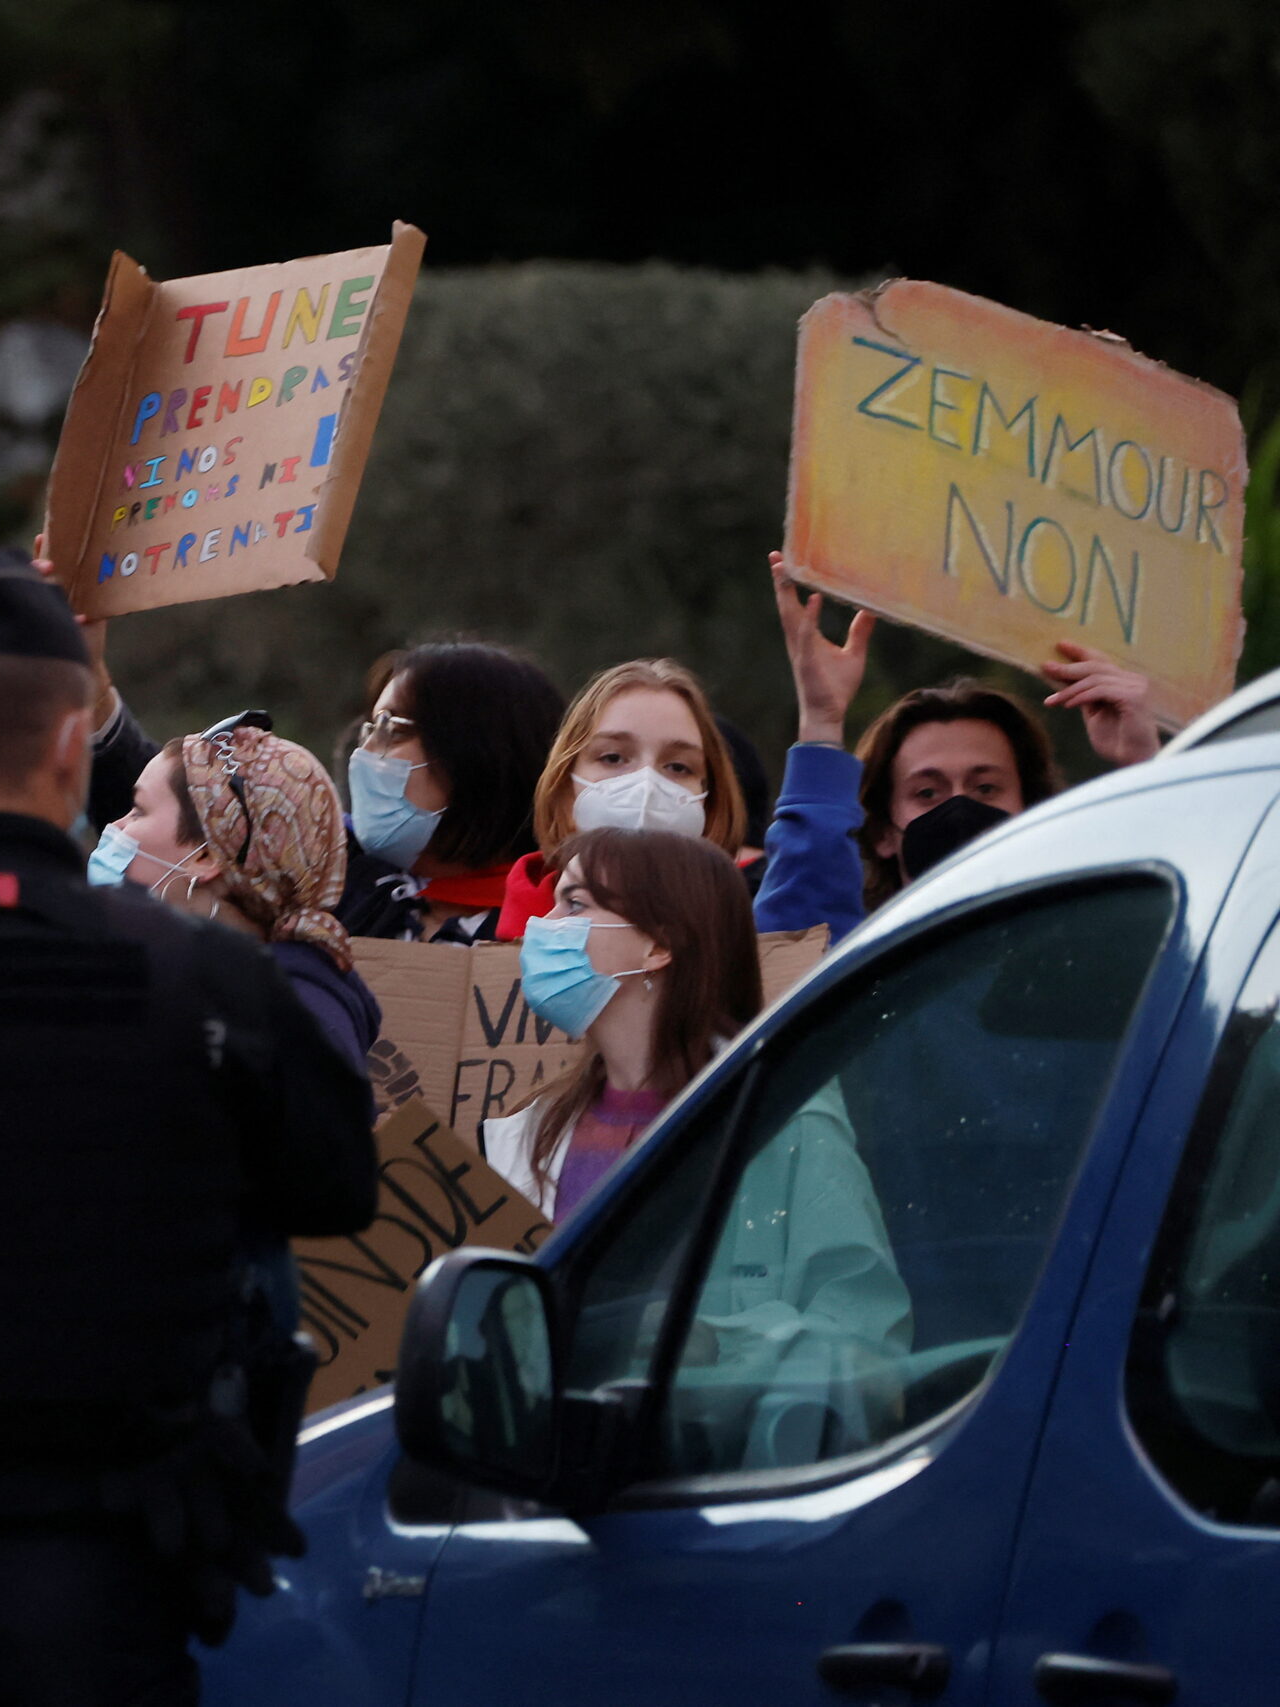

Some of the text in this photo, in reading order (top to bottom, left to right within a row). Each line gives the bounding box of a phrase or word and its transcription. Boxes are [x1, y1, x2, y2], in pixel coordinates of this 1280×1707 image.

[128, 350, 358, 446] PRENDRAS
[175, 436, 245, 482] NOS
[852, 336, 1229, 553] ZEMMOUR
[943, 482, 1139, 644] NON
